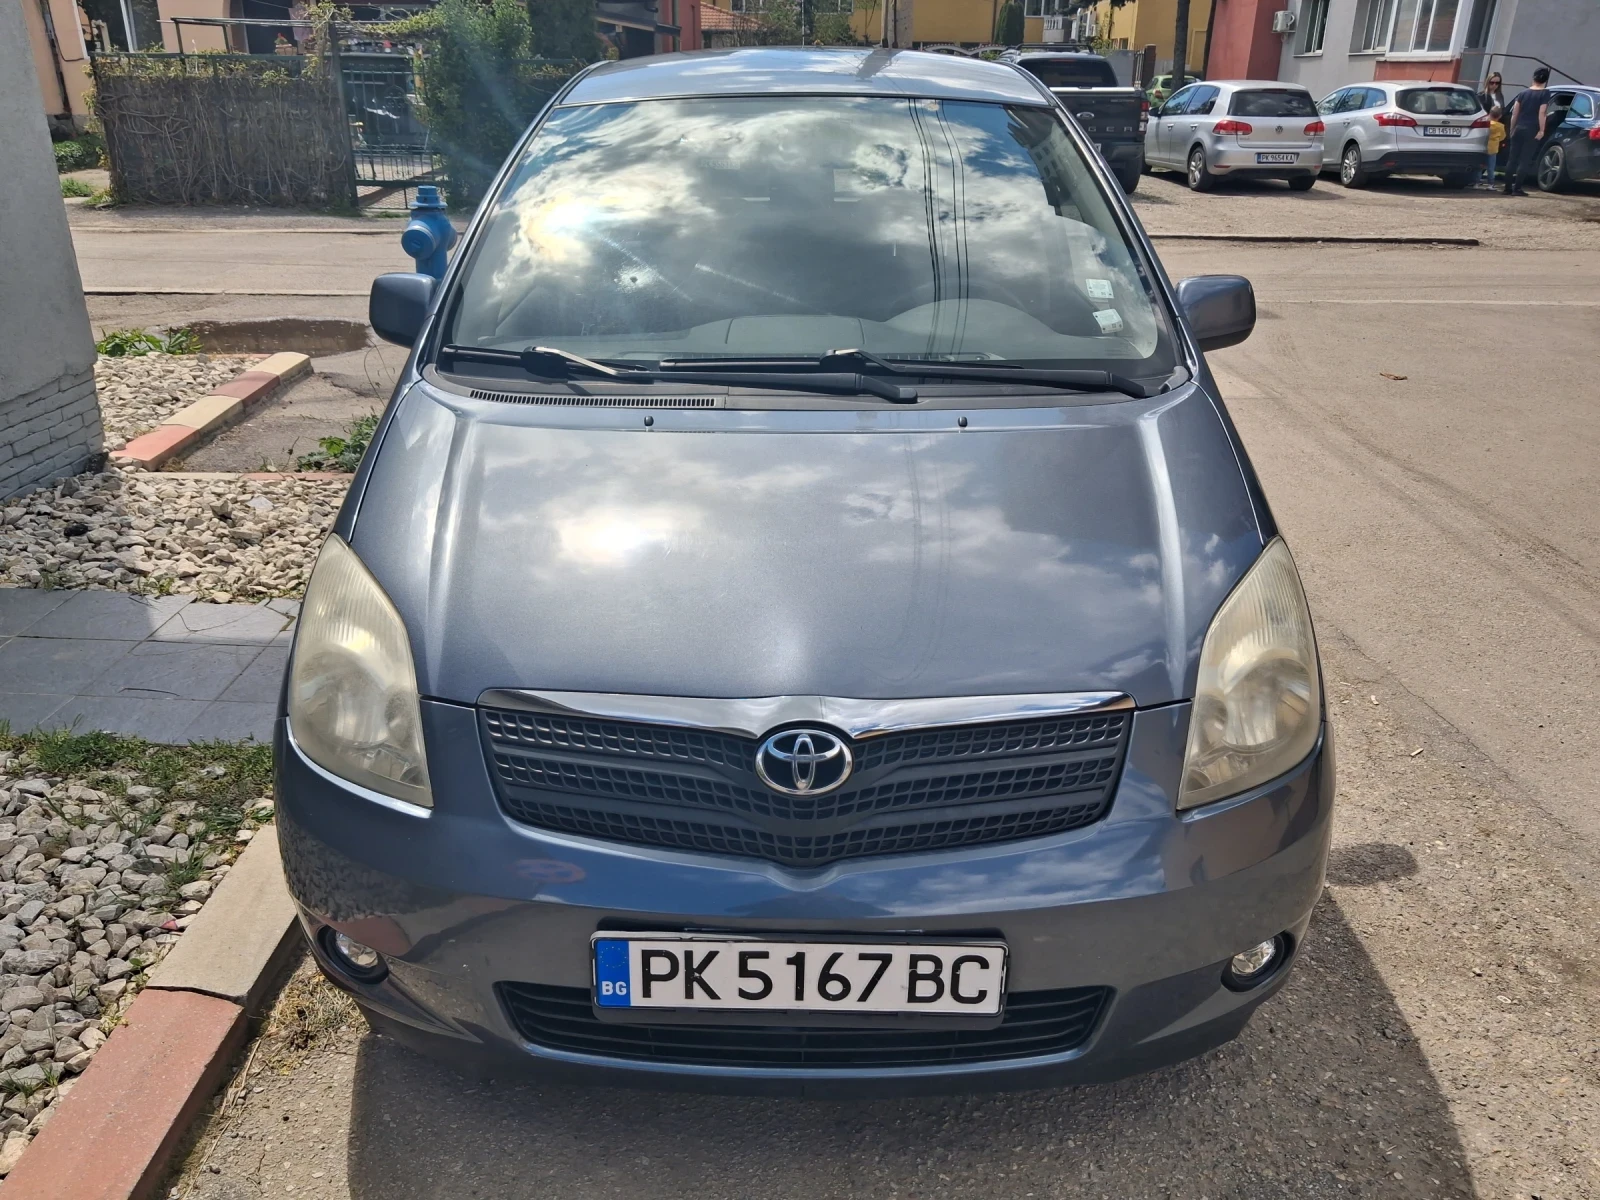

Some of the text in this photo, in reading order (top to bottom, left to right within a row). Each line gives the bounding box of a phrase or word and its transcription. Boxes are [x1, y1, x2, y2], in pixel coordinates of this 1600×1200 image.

[601, 980, 627, 996] BG
[641, 948, 990, 1005] PK 5167 BC
